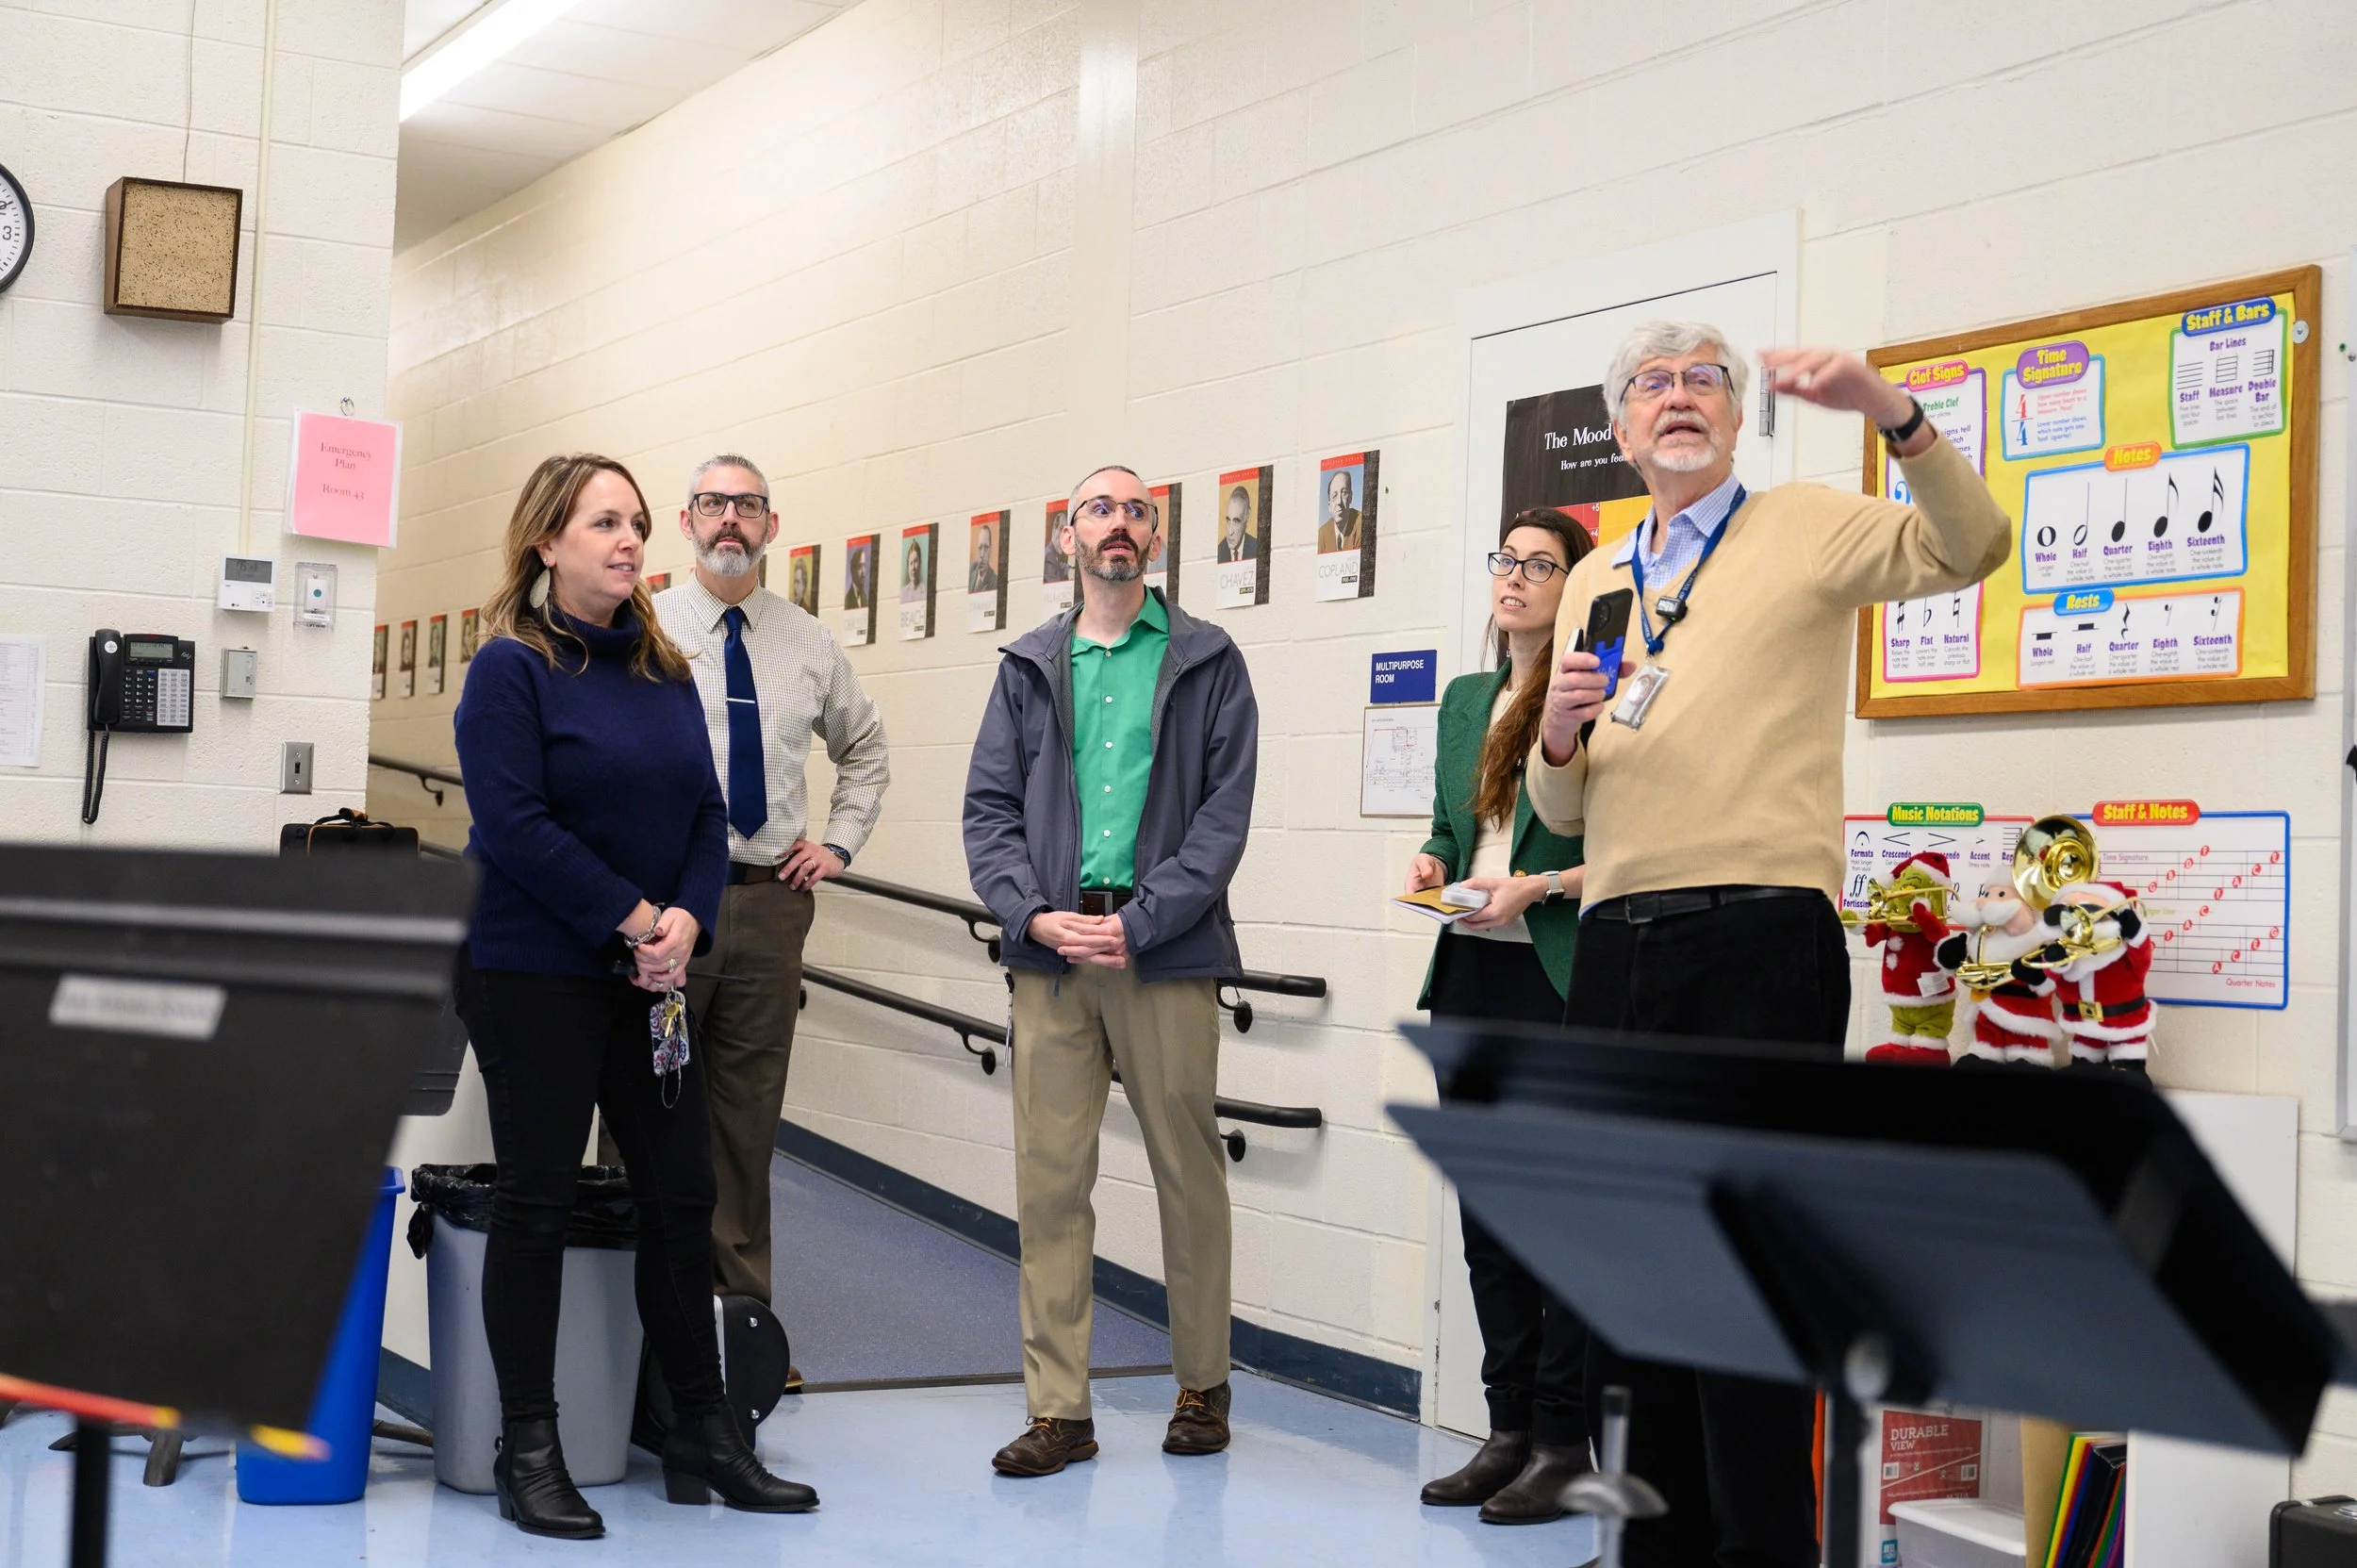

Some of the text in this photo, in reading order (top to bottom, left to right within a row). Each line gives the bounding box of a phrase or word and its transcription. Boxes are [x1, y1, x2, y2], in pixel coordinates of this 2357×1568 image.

[3, 225, 12, 240] 3
[2186, 304, 2269, 331] Staff & Bars
[2209, 338, 2247, 352] Bar Lines
[2036, 349, 2068, 366] Time
[1909, 365, 1965, 387] Clef Signs
[2022, 362, 2083, 385] Signature
[2248, 378, 2277, 391] Double
[2179, 389, 2200, 404] Staff
[2209, 385, 2243, 398] Measure
[2254, 391, 2269, 403] Bar
[1945, 396, 1959, 408] Clef
[2015, 394, 2027, 419] 4
[1544, 423, 1612, 450] The Mood
[2016, 421, 2028, 446] 4
[321, 441, 371, 461] Emergency
[2113, 448, 2151, 465] Notes
[335, 458, 355, 470] Plan
[1560, 460, 1577, 470] How
[1580, 459, 1592, 468] are
[1594, 457, 1608, 468] you
[322, 484, 364, 501] Room 43
[2148, 539, 2173, 553] Eighth
[2186, 534, 2226, 548] Sixteenth
[2072, 548, 2087, 559] Half
[2102, 545, 2133, 556] Quarter
[2035, 552, 2057, 563] Whole
[1319, 561, 1359, 578] COPLAND
[1220, 570, 1255, 588] CHAVEZ
[2067, 594, 2101, 610] Rests
[1890, 637, 1911, 649] Sharp
[1920, 635, 1934, 646] Flat
[1943, 634, 1970, 644] Natural
[2152, 637, 2179, 651] Eighth
[2193, 634, 2233, 646] Sixteenth
[2032, 647, 2053, 657] Whole
[2076, 643, 2092, 653] Half
[2108, 641, 2139, 652] Quarter
[1376, 659, 1425, 671] MULTIPURPOSE
[1375, 674, 1394, 684] ROOM
[1891, 806, 1979, 821] Music Notations
[2103, 803, 2188, 820] Staff & Notes
[1851, 849, 1873, 858] Fermata
[1882, 850, 1912, 858] Crescendo
[1970, 851, 1990, 860] Accent
[2002, 852, 2014, 862] Rep
[2102, 852, 2150, 864] Time Signature
[1843, 900, 1871, 908] Fortissim
[2226, 978, 2276, 988] Quarter Notes
[1890, 1425, 1949, 1440] DURABLE
[1890, 1440, 1915, 1451] VIEW
